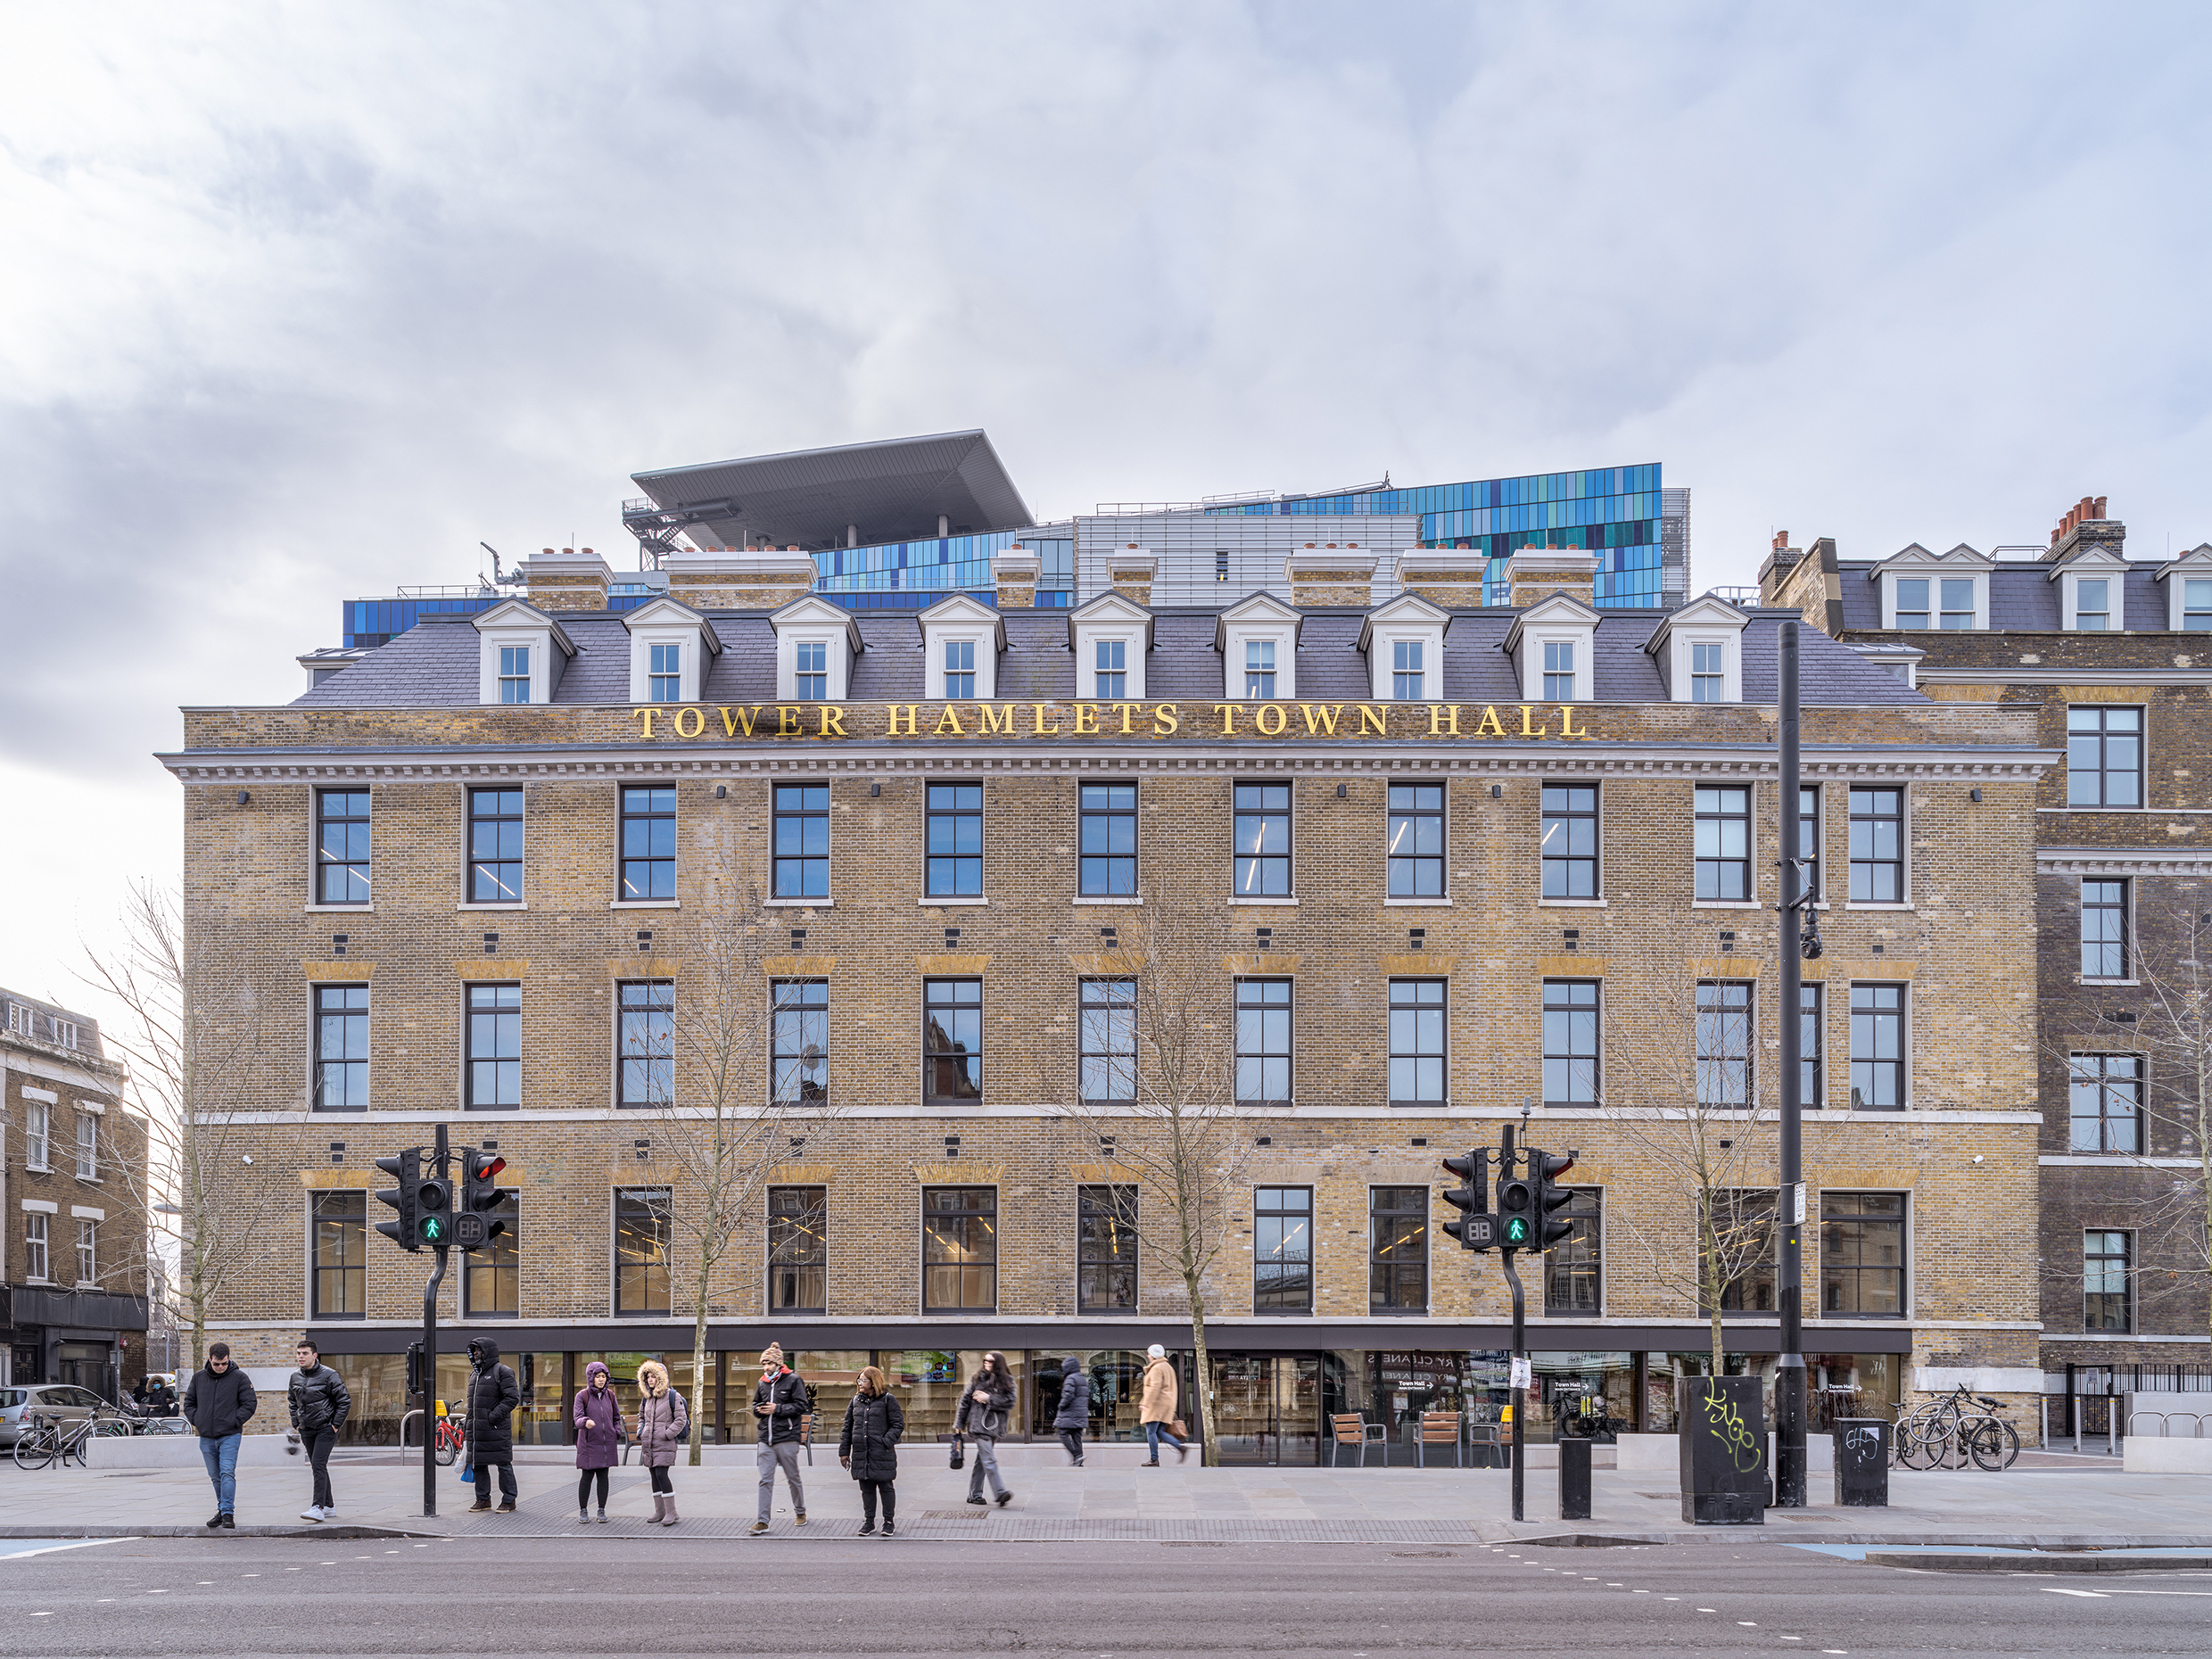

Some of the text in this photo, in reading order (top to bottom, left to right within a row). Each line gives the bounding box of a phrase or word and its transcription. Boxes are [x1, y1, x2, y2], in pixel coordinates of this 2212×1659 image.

[633, 703, 1586, 739] TOWER HAMLETS TOWN HALL
